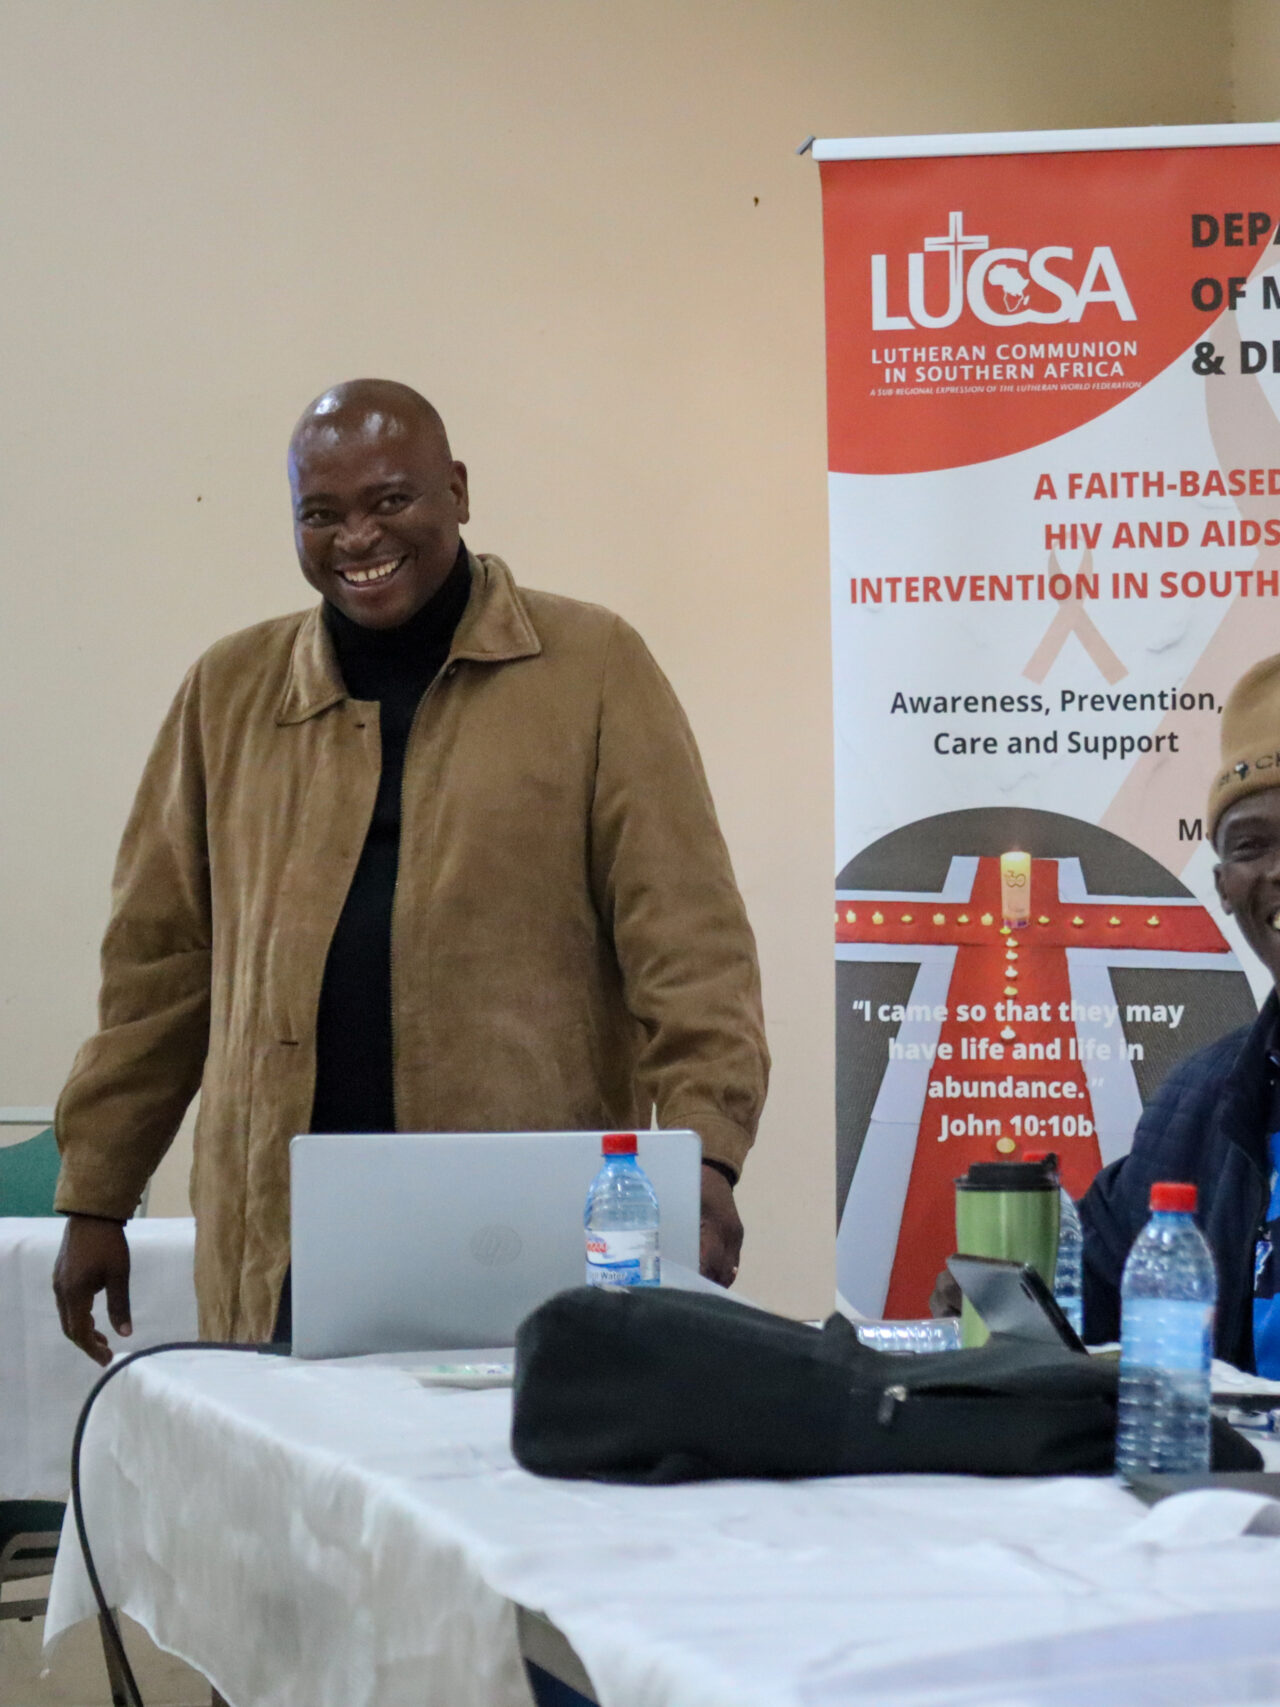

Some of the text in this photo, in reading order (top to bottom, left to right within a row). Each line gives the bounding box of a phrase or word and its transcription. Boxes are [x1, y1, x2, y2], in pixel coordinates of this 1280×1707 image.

[871, 238, 1138, 330] LUCSA
[1191, 276, 1248, 312] OF
[871, 341, 1138, 364] LUTHERAN COMMUNION
[1191, 340, 1226, 376] &
[885, 361, 1125, 383] IN SOUTHERN AFRICA
[936, 384, 984, 394] EXPRESSION
[1000, 384, 1014, 392] THE
[1017, 383, 1058, 392] LUTHERAN
[1060, 382, 1090, 391] WORLD
[1092, 380, 1142, 390] FEDERATION
[1034, 473, 1057, 500] A
[1044, 523, 1102, 550] HIV
[1112, 521, 1189, 549] AND
[850, 574, 1100, 604] INTERVENTION
[1112, 573, 1147, 600] IN
[890, 687, 1224, 716] Awareness, Prevention,
[934, 728, 1180, 761] Care and Support
[877, 1004, 948, 1023] came
[956, 1004, 987, 1023] so
[995, 1000, 1051, 1023] that
[1058, 999, 1119, 1029] they
[1126, 1004, 1185, 1029] may
[888, 1036, 1144, 1061] have life and life in
[937, 1113, 1094, 1143] John 10:10b
